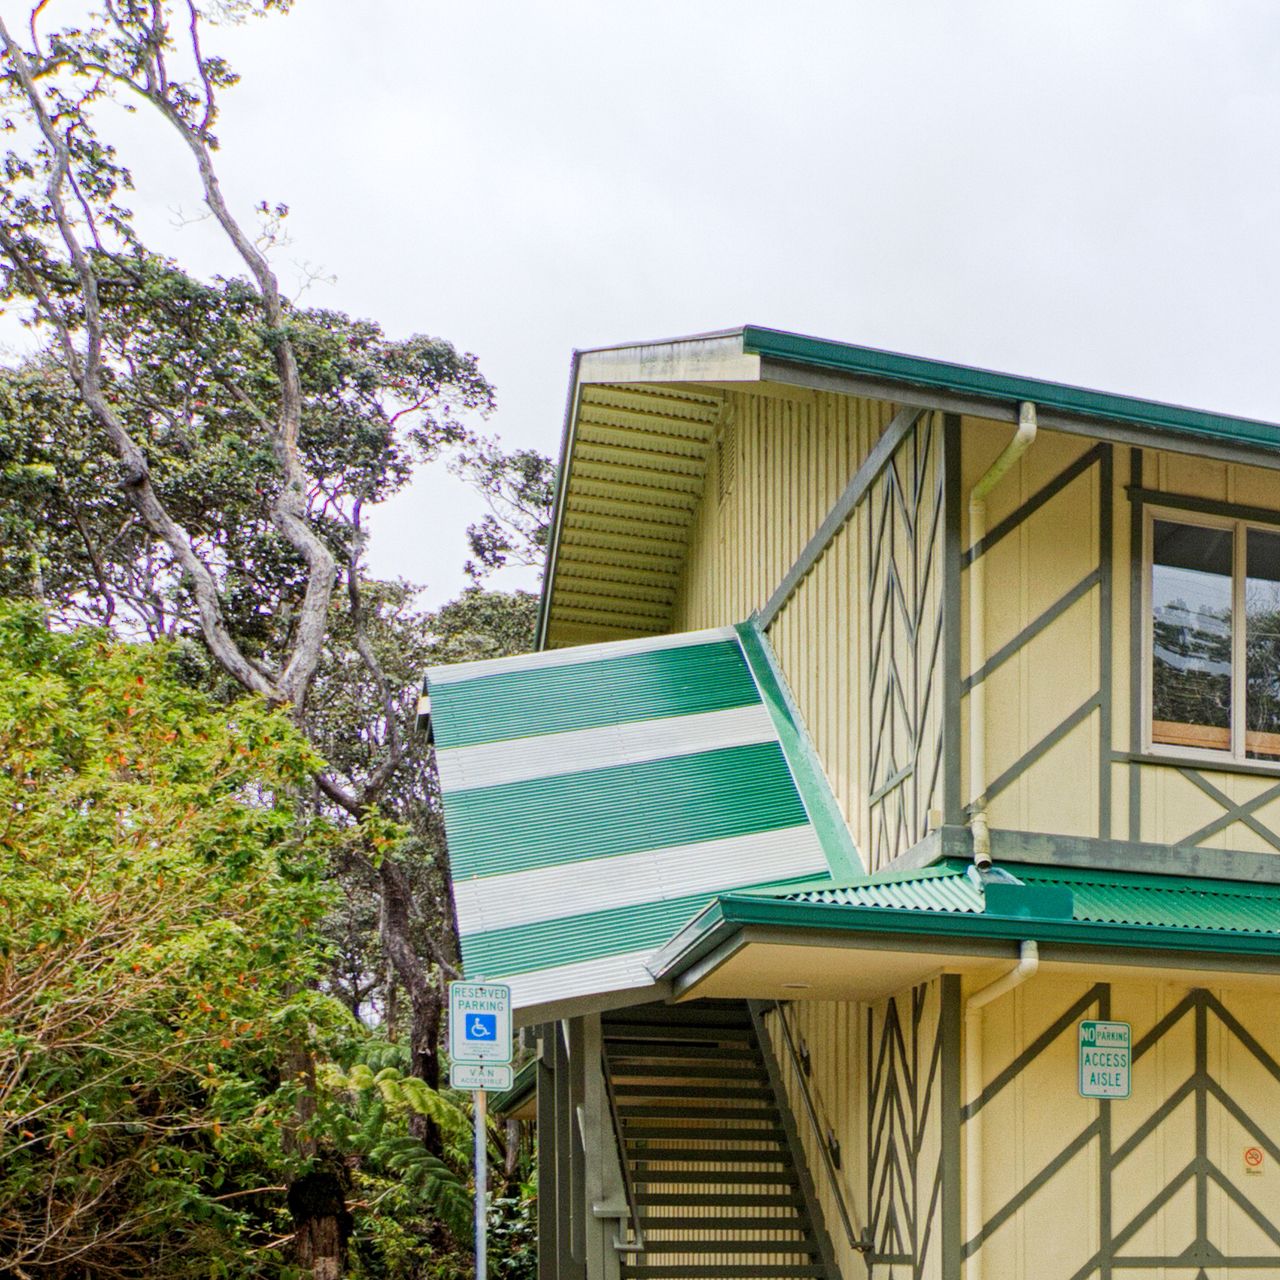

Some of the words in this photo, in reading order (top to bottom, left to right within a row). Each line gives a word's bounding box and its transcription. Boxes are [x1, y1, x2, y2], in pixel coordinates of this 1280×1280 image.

[455, 987, 507, 999] RESERVED
[458, 1000, 504, 1011] PARKING
[1081, 1027, 1096, 1042] NO
[1097, 1031, 1128, 1042] PARKING
[1085, 1053, 1127, 1068] ACCESS
[470, 1069, 494, 1077] VAN
[1090, 1072, 1121, 1087] AISLE
